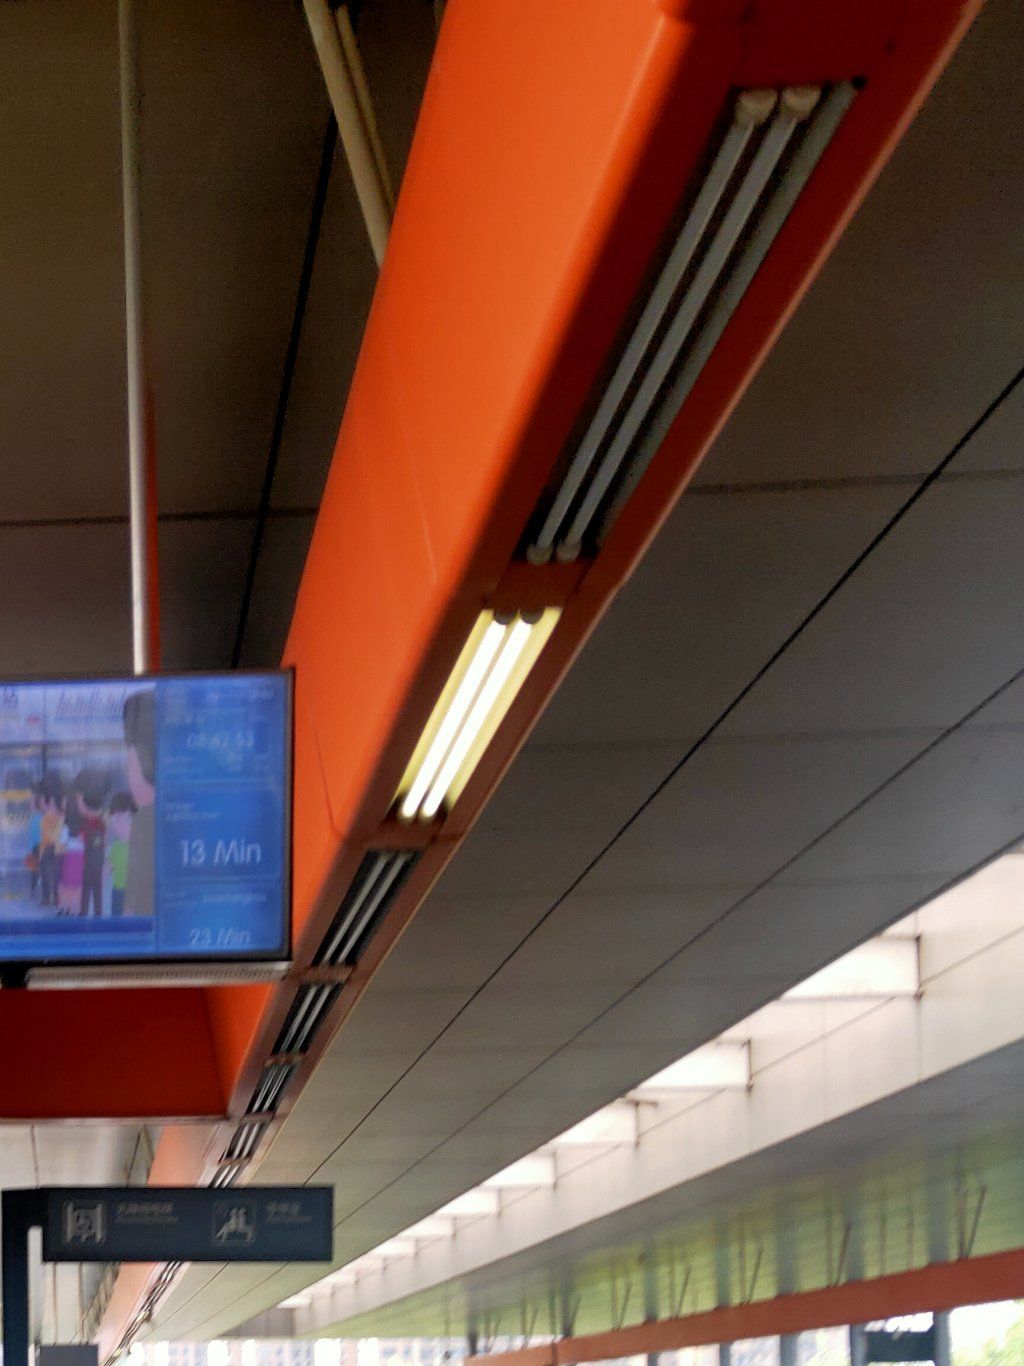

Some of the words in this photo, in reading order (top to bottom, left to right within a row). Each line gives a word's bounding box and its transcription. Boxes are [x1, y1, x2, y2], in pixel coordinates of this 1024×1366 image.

[180, 838, 206, 866] 13
[213, 838, 262, 866] Min
[217, 927, 251, 946] Min
